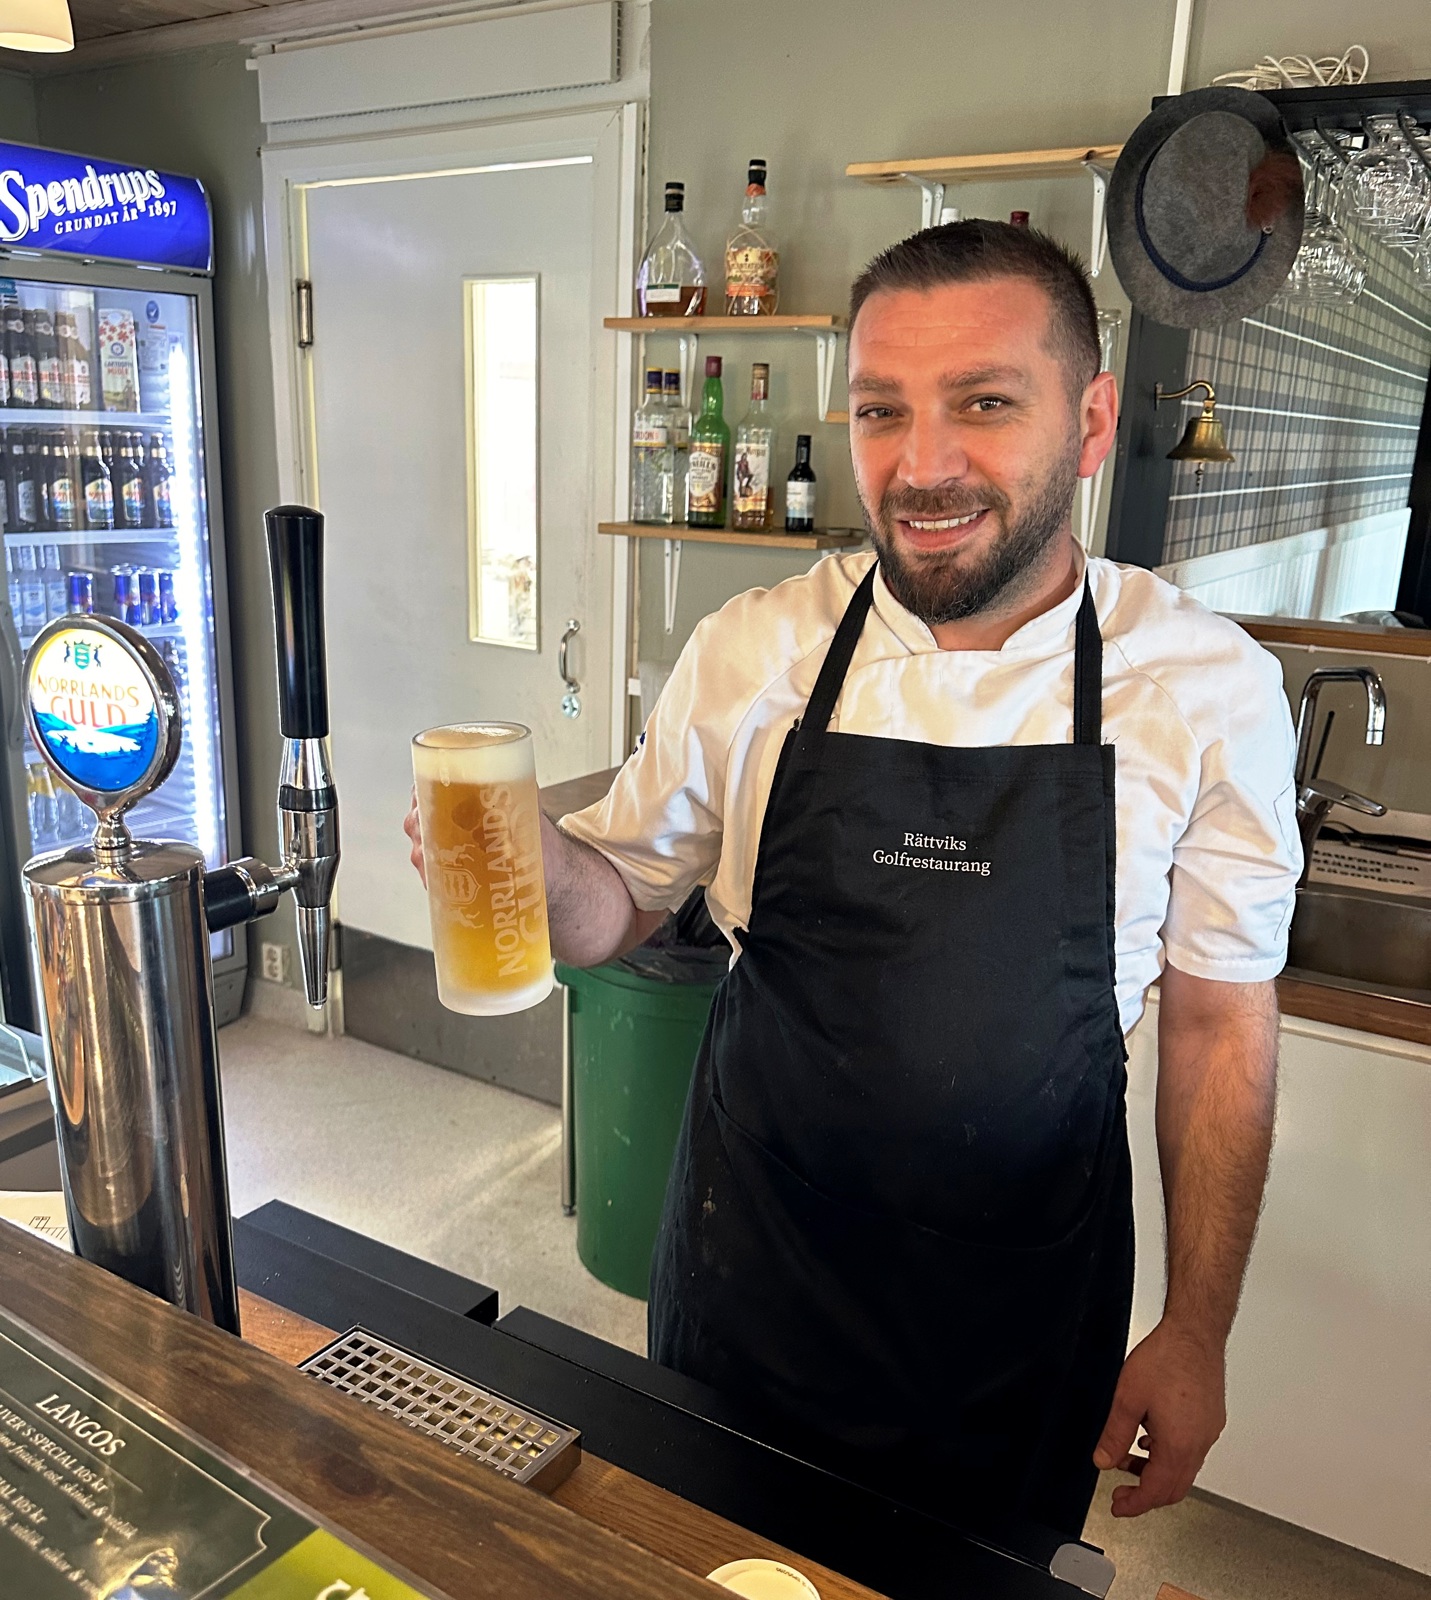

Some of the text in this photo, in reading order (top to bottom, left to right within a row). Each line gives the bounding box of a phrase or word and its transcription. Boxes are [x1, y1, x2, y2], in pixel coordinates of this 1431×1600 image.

[0, 165, 165, 242] Spendrups
[54, 200, 178, 235] GRUNDAT ÅR 1897
[37, 674, 140, 708] NORRLANDS
[50, 695, 127, 728] GULD
[903, 832, 967, 851] Rättviks
[872, 849, 991, 876] Golfrestaurang
[479, 783, 529, 978] NORRLANDS
[35, 1393, 126, 1456] LANGOS
[30, 1433, 78, 1470] SPECIAL
[73, 1465, 97, 1483] 105
[91, 1477, 108, 1493] kr
[11, 1494, 37, 1514] 105
[29, 1507, 48, 1524] kr
